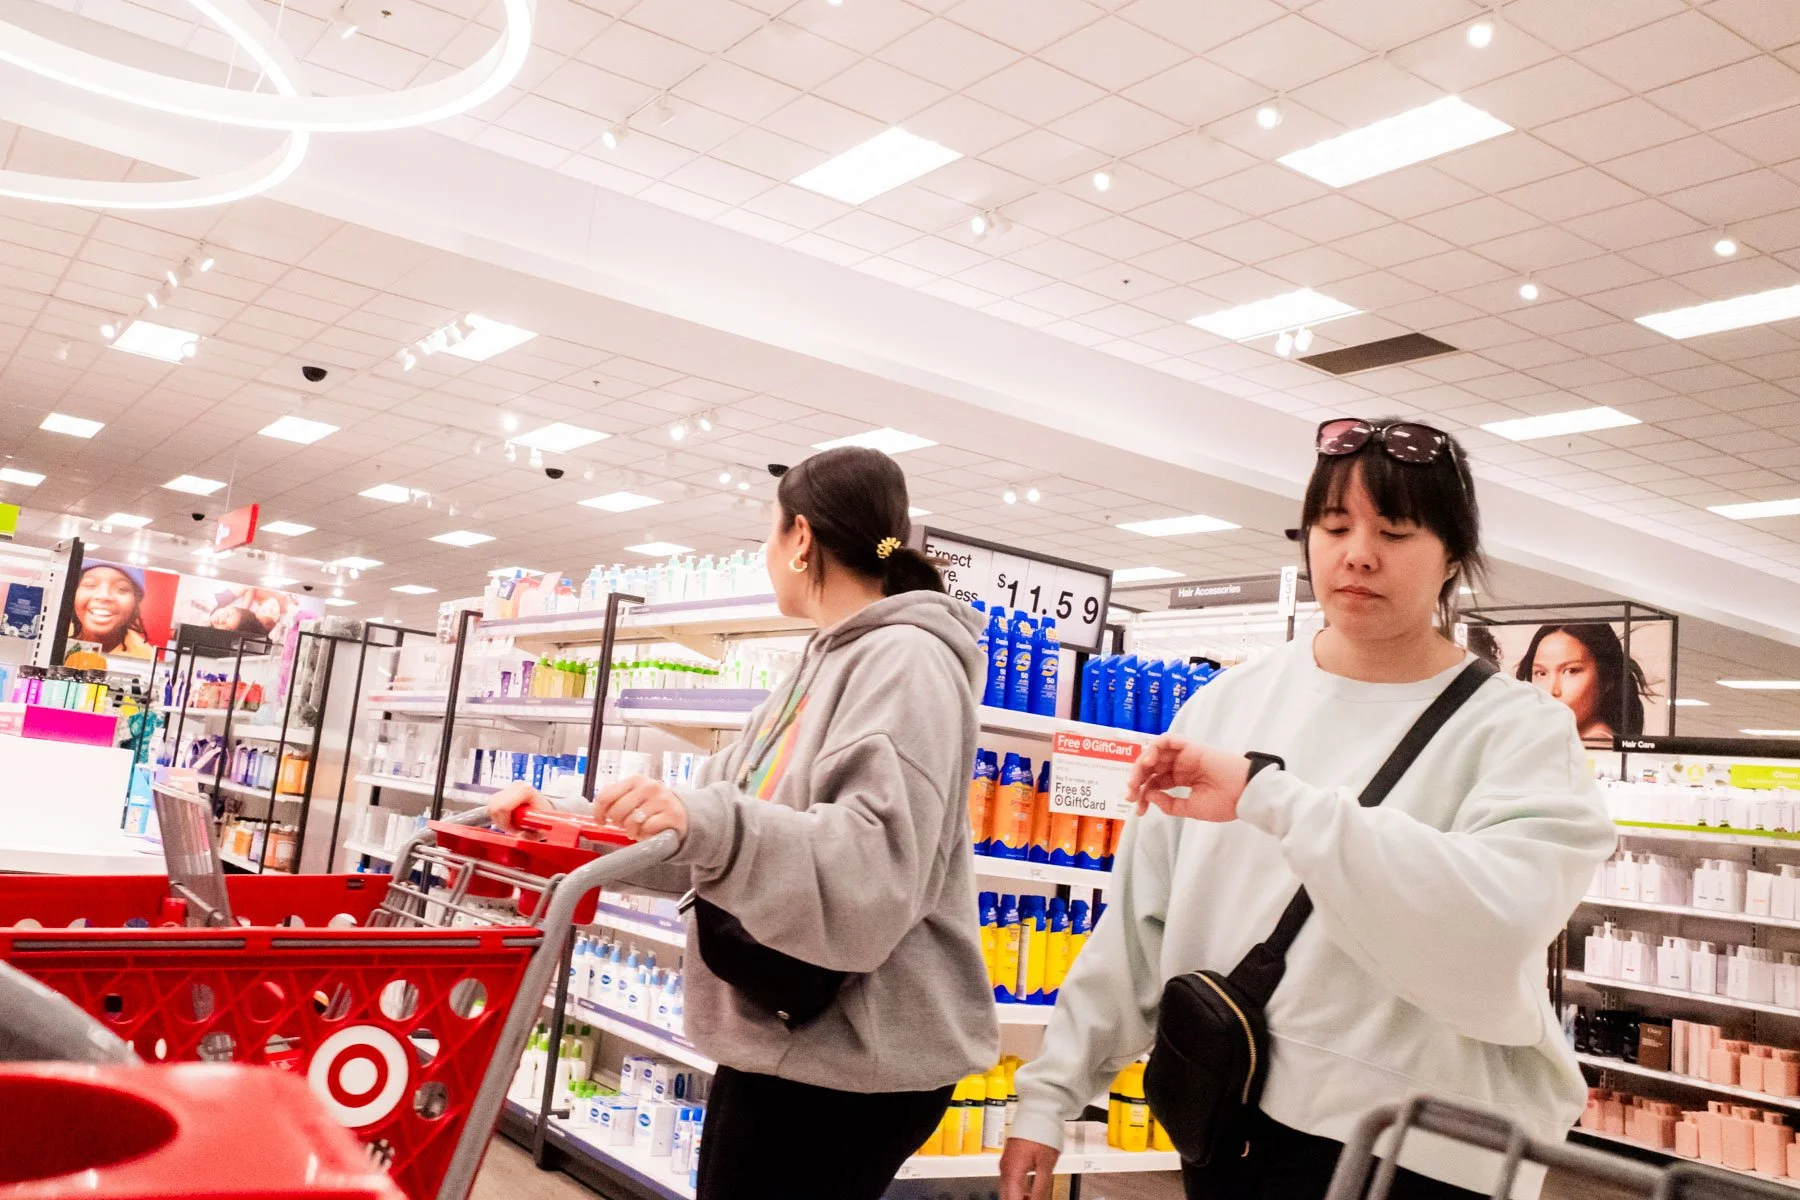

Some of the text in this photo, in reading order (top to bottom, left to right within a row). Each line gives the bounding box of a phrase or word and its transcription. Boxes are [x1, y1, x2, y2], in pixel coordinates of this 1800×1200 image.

[1178, 584, 1241, 598] Hair Accessories
[1057, 735, 1080, 748] Free
[1091, 740, 1133, 755] GiftCard
[1621, 740, 1655, 749] Hair Care
[1055, 782, 1092, 797] Free $5
[1064, 795, 1106, 811] GiftCard
